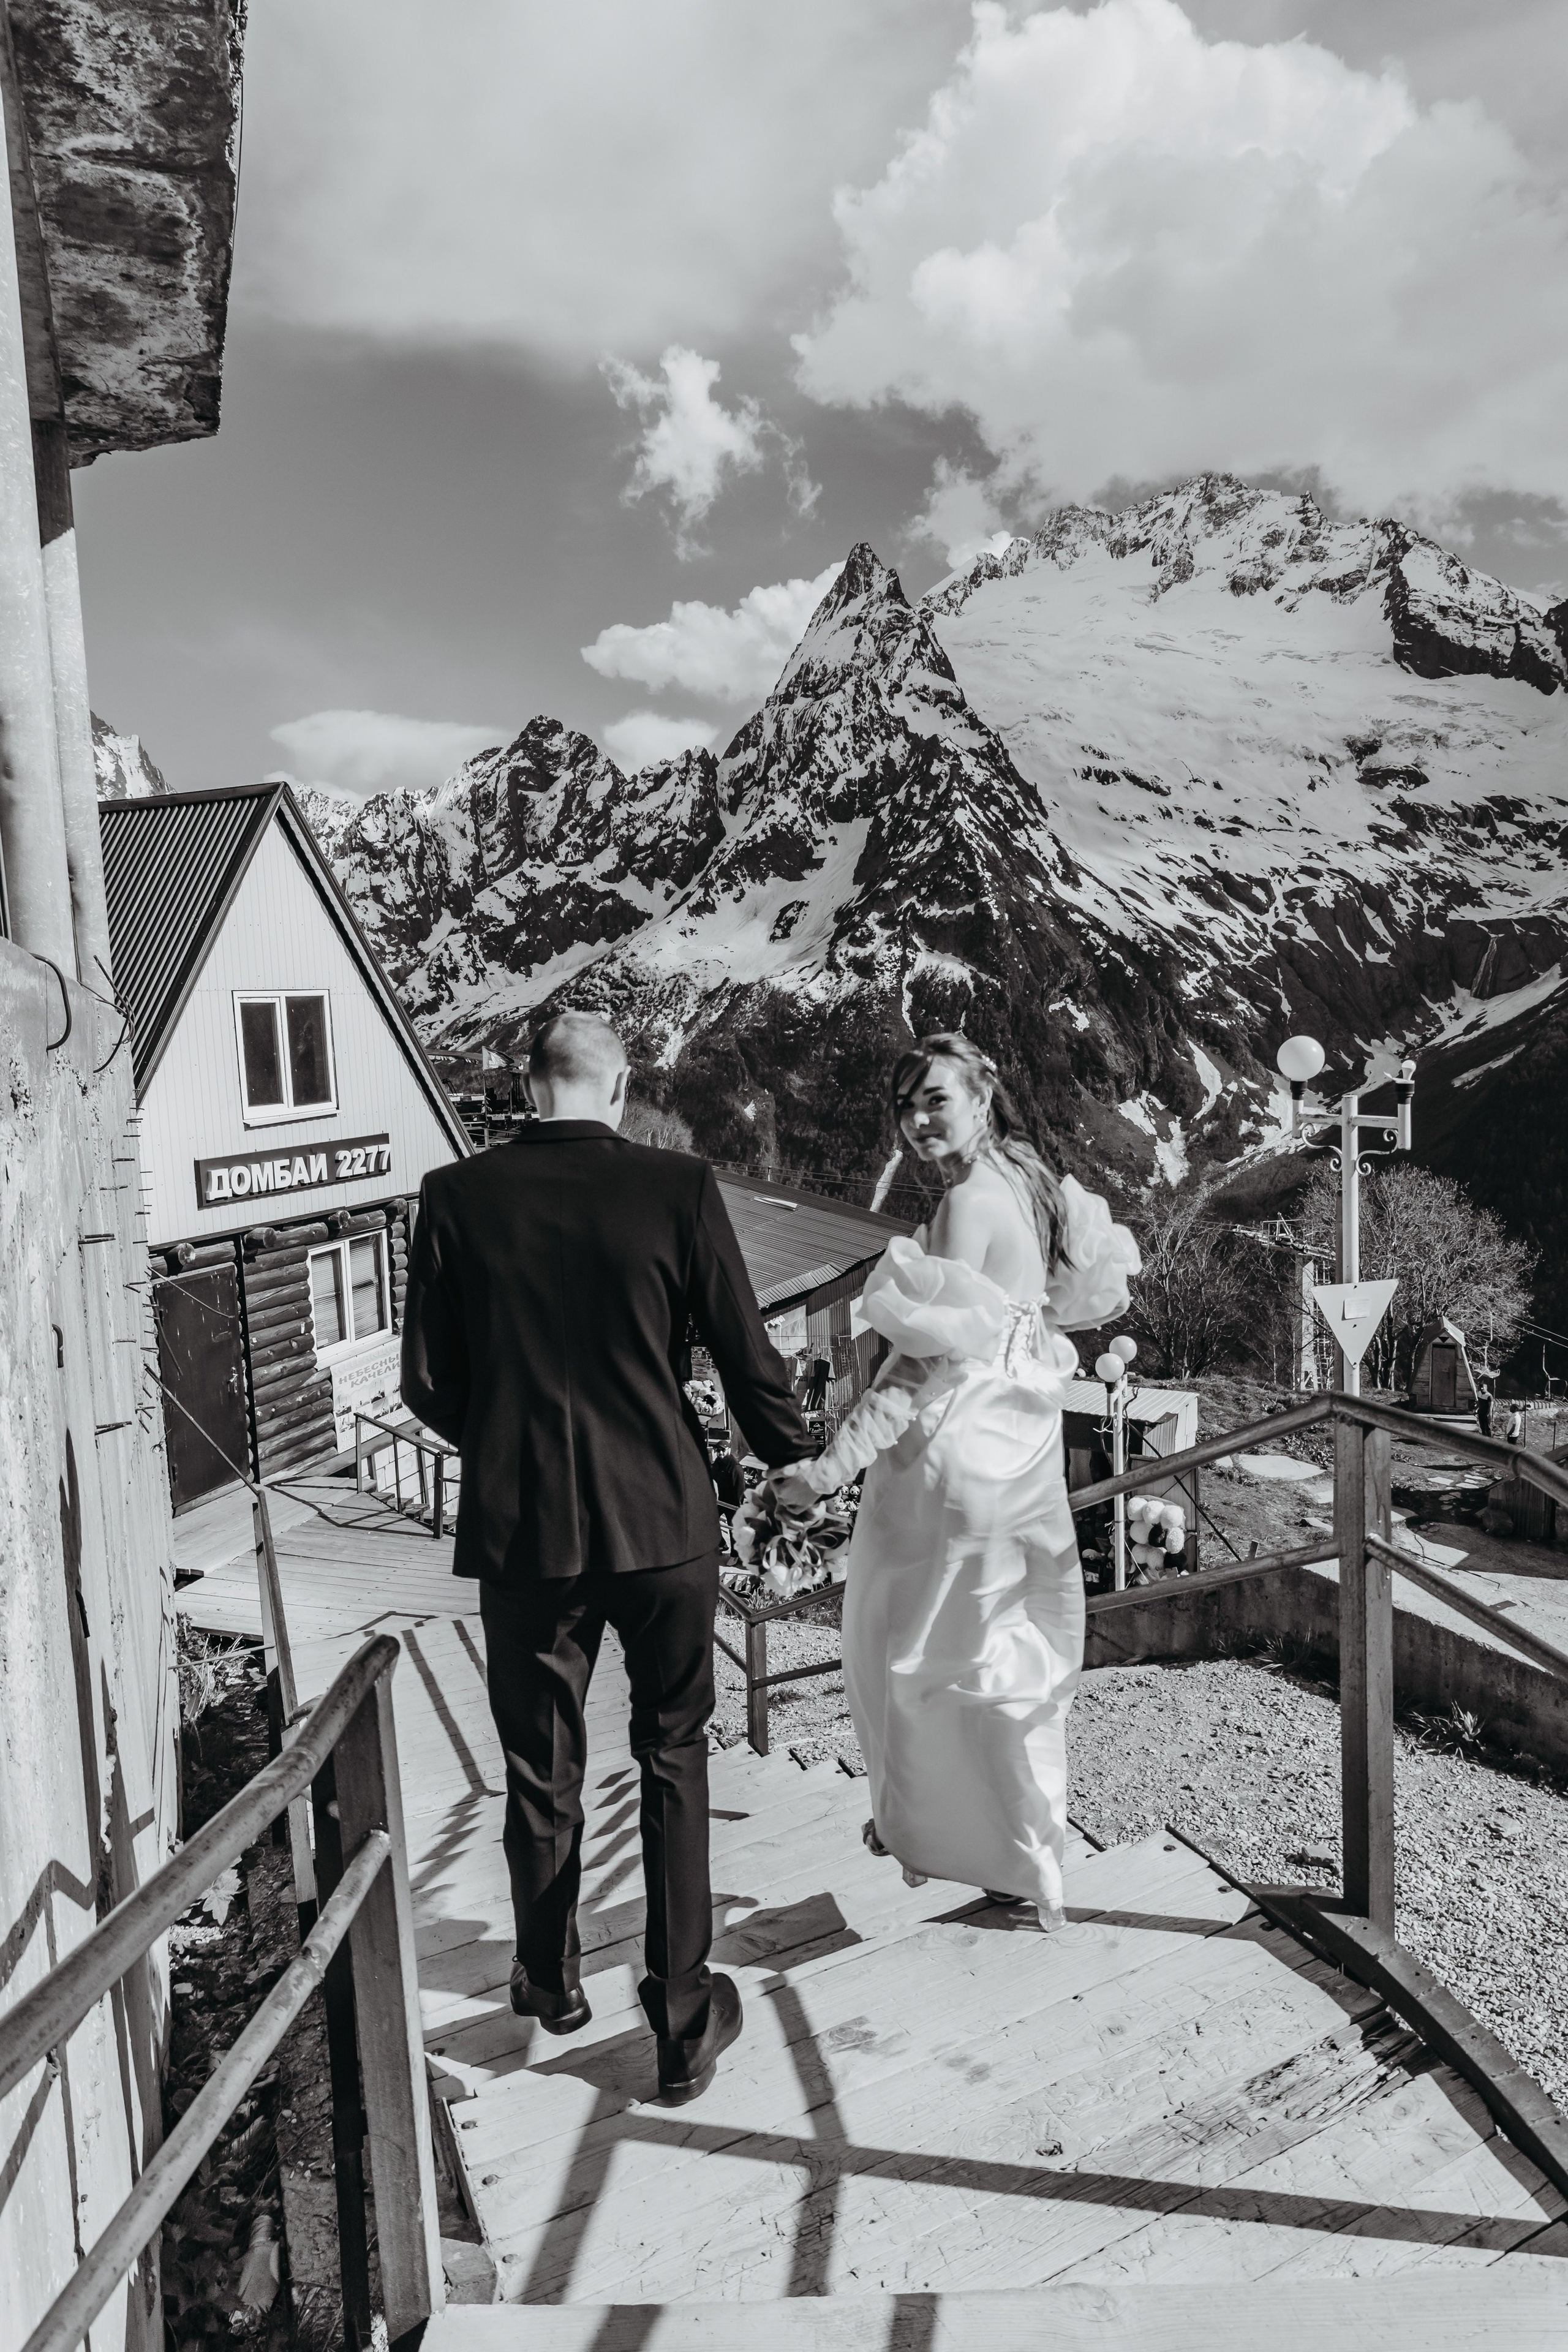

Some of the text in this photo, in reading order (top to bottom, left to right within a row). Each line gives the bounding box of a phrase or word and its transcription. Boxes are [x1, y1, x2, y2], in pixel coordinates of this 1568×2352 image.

[334, 1143, 391, 1178] 2277
[338, 1353, 399, 1385] НЕБЕСНЫ
[350, 1360, 401, 1389] КАЧЕЛИ
